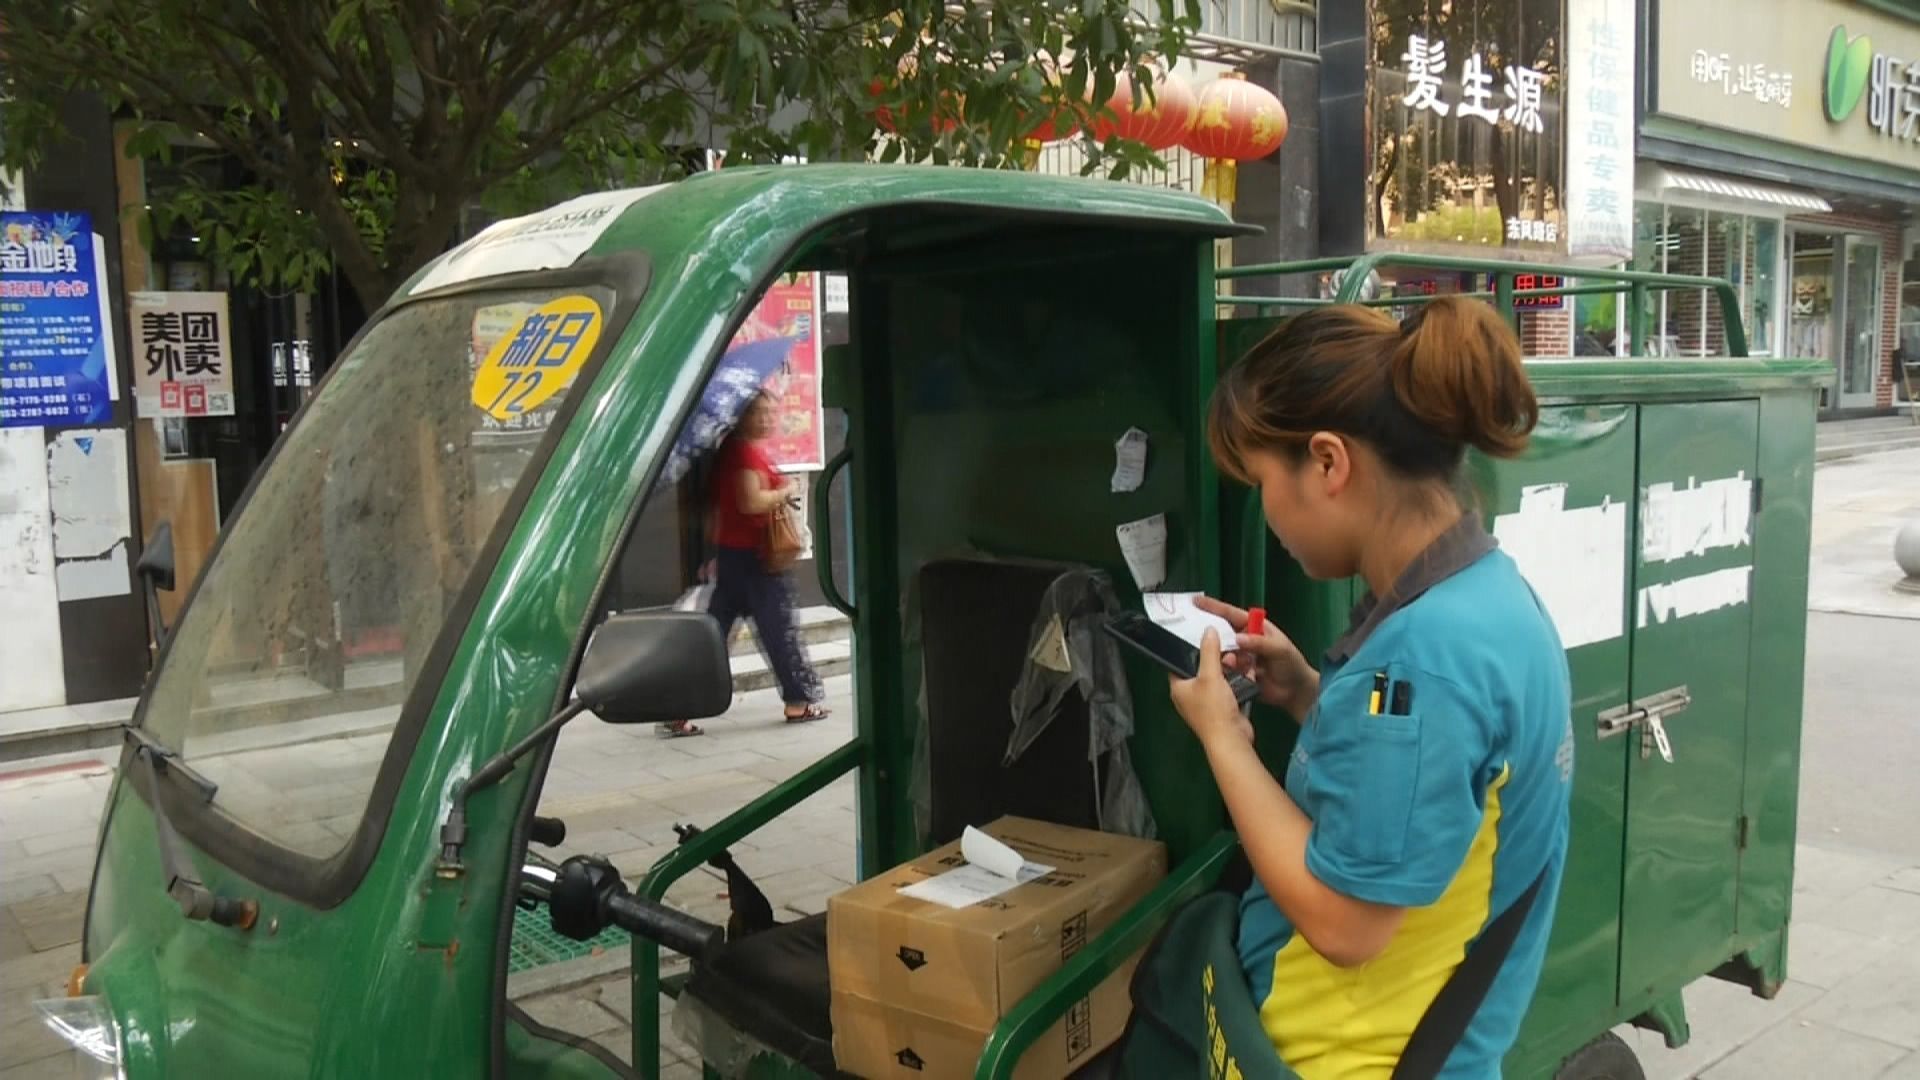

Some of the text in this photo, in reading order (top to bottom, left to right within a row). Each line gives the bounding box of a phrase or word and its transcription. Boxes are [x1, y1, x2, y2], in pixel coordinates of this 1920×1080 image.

[1401, 34, 1544, 133] 髮生源
[142, 312, 220, 344] 美团
[498, 312, 596, 367] 新日
[146, 344, 222, 382] 外卖
[487, 371, 543, 412] 72
